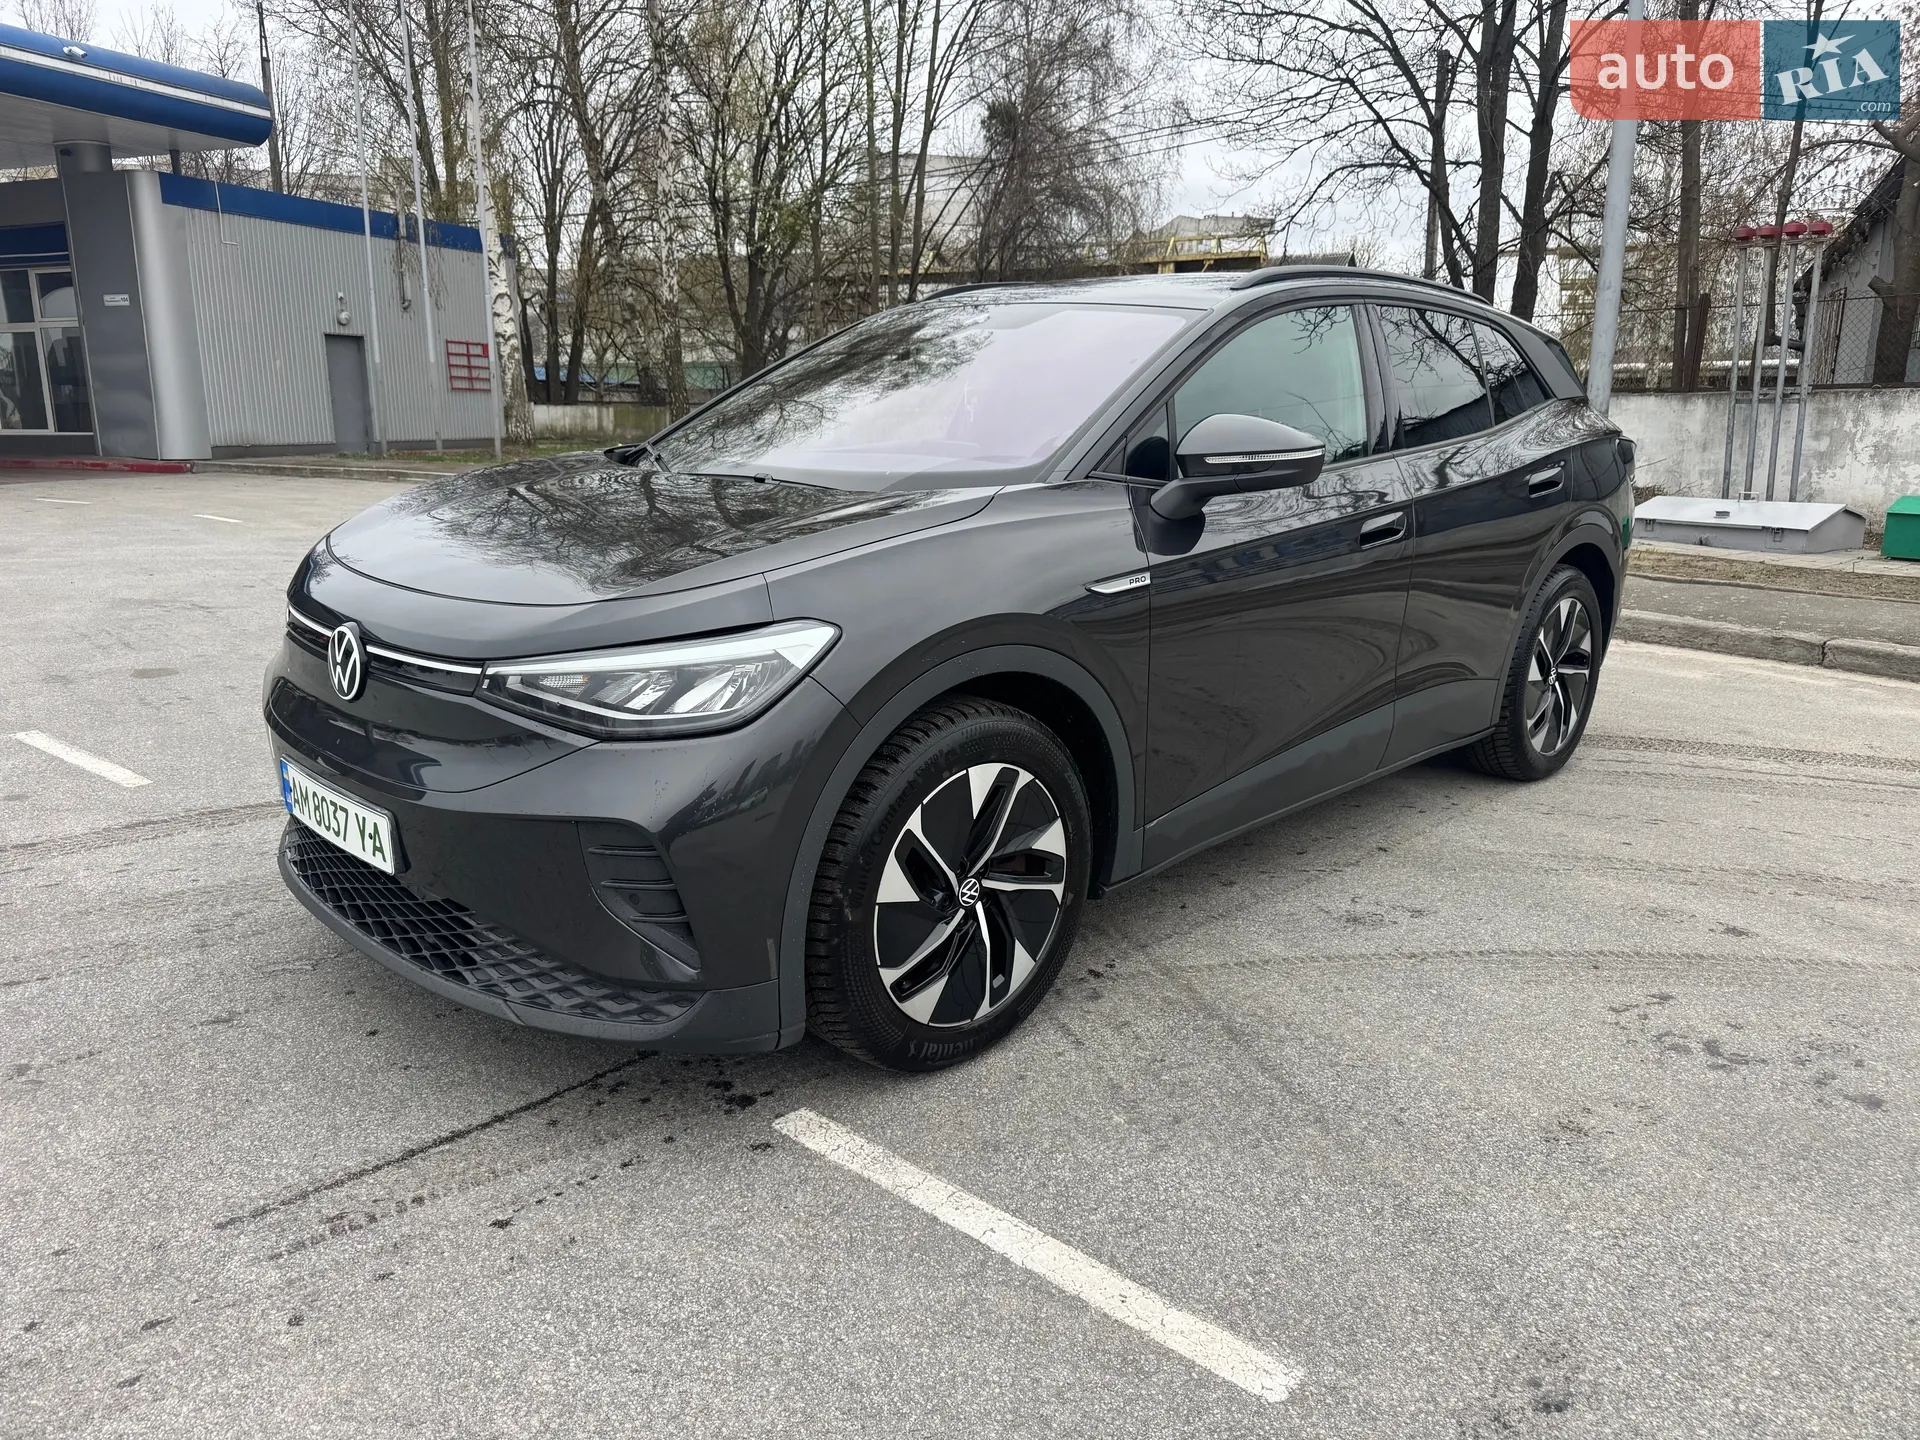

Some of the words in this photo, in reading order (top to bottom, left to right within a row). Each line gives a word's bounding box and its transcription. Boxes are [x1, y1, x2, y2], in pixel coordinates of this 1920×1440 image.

[1129, 575, 1147, 585] PRO
[924, 754, 939, 768] 870
[292, 776, 312, 821] AM
[312, 791, 349, 842] 8037
[355, 812, 387, 863] YA
